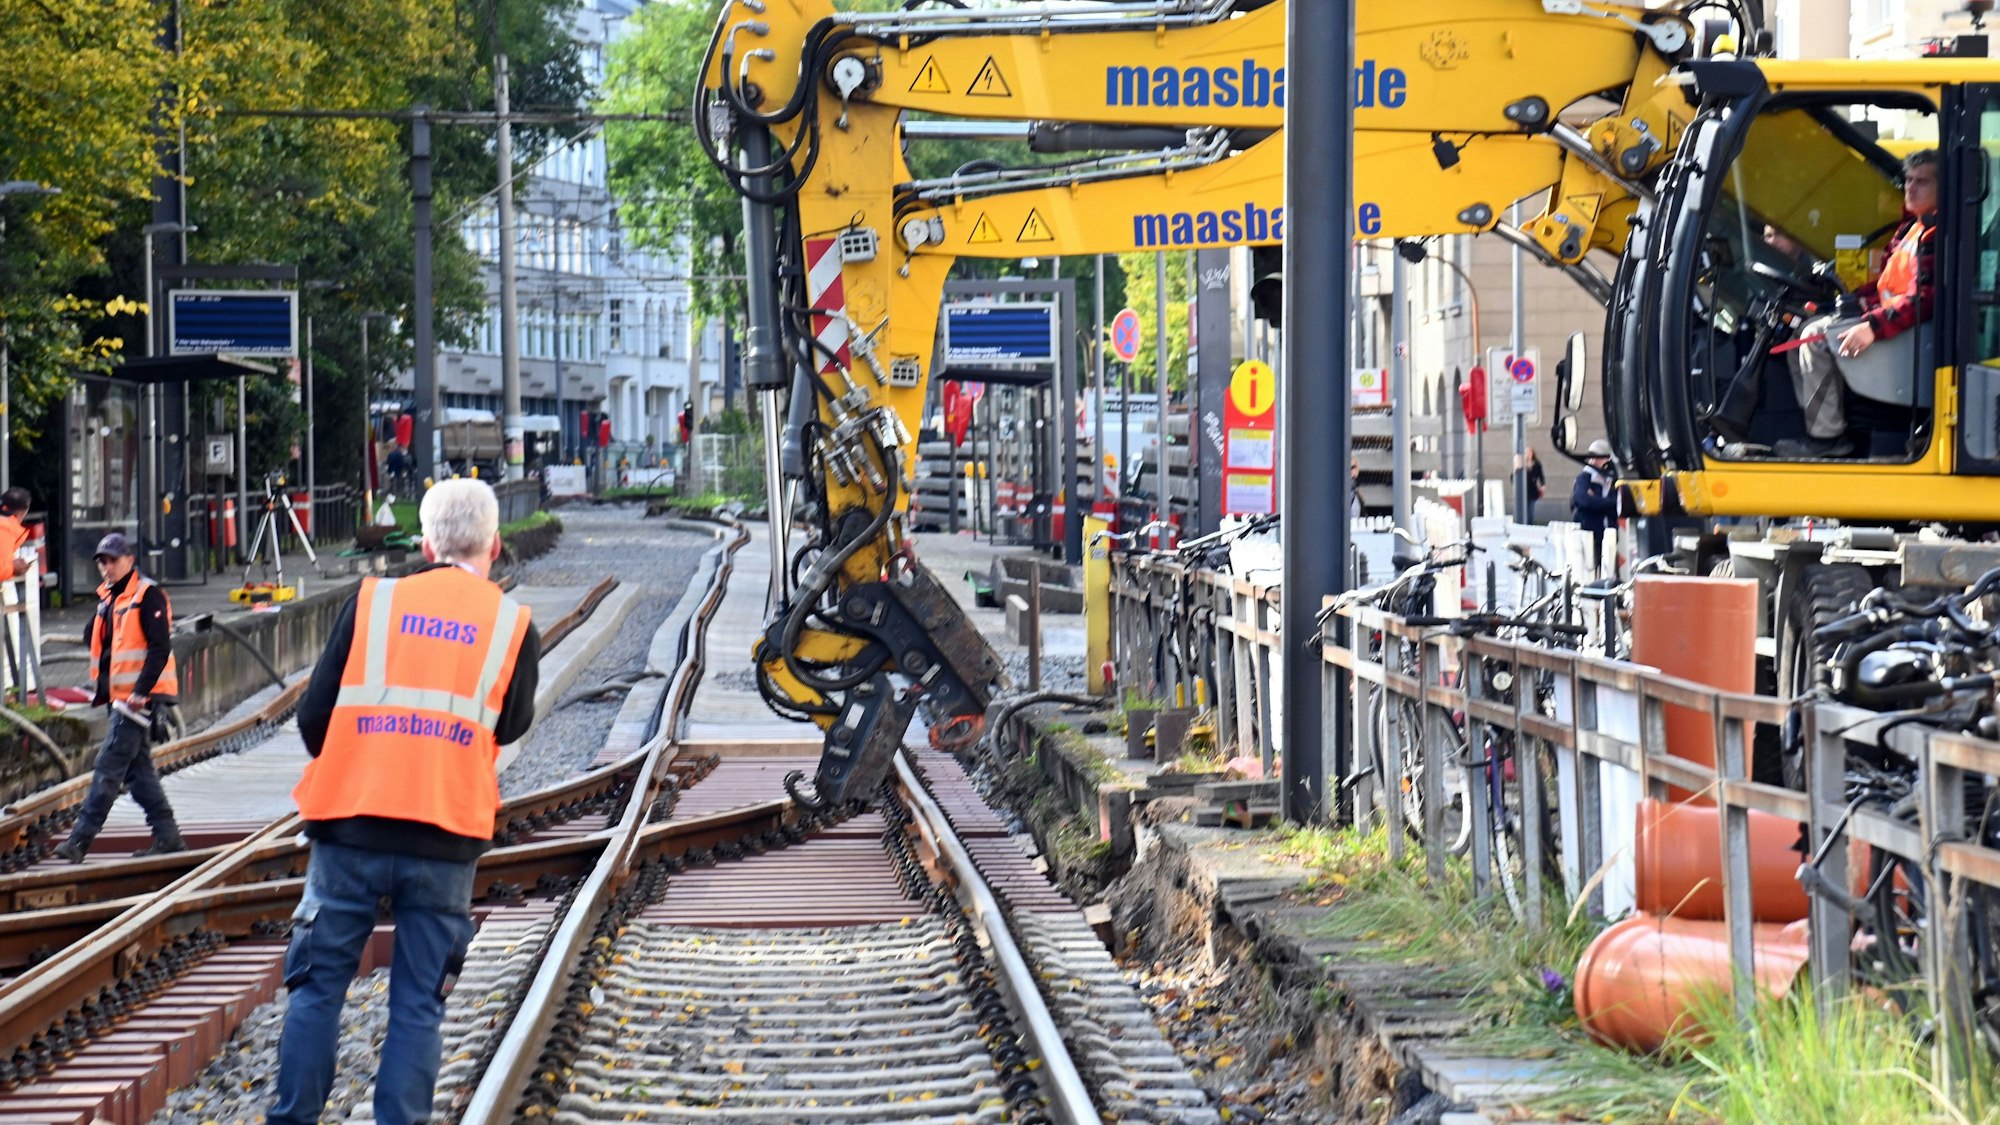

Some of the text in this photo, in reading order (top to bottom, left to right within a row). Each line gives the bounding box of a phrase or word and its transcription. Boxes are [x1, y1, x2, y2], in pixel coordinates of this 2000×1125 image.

[1106, 59, 1406, 108] maasbde
[401, 614, 477, 645] maas
[357, 713, 473, 747] maasbau.de
